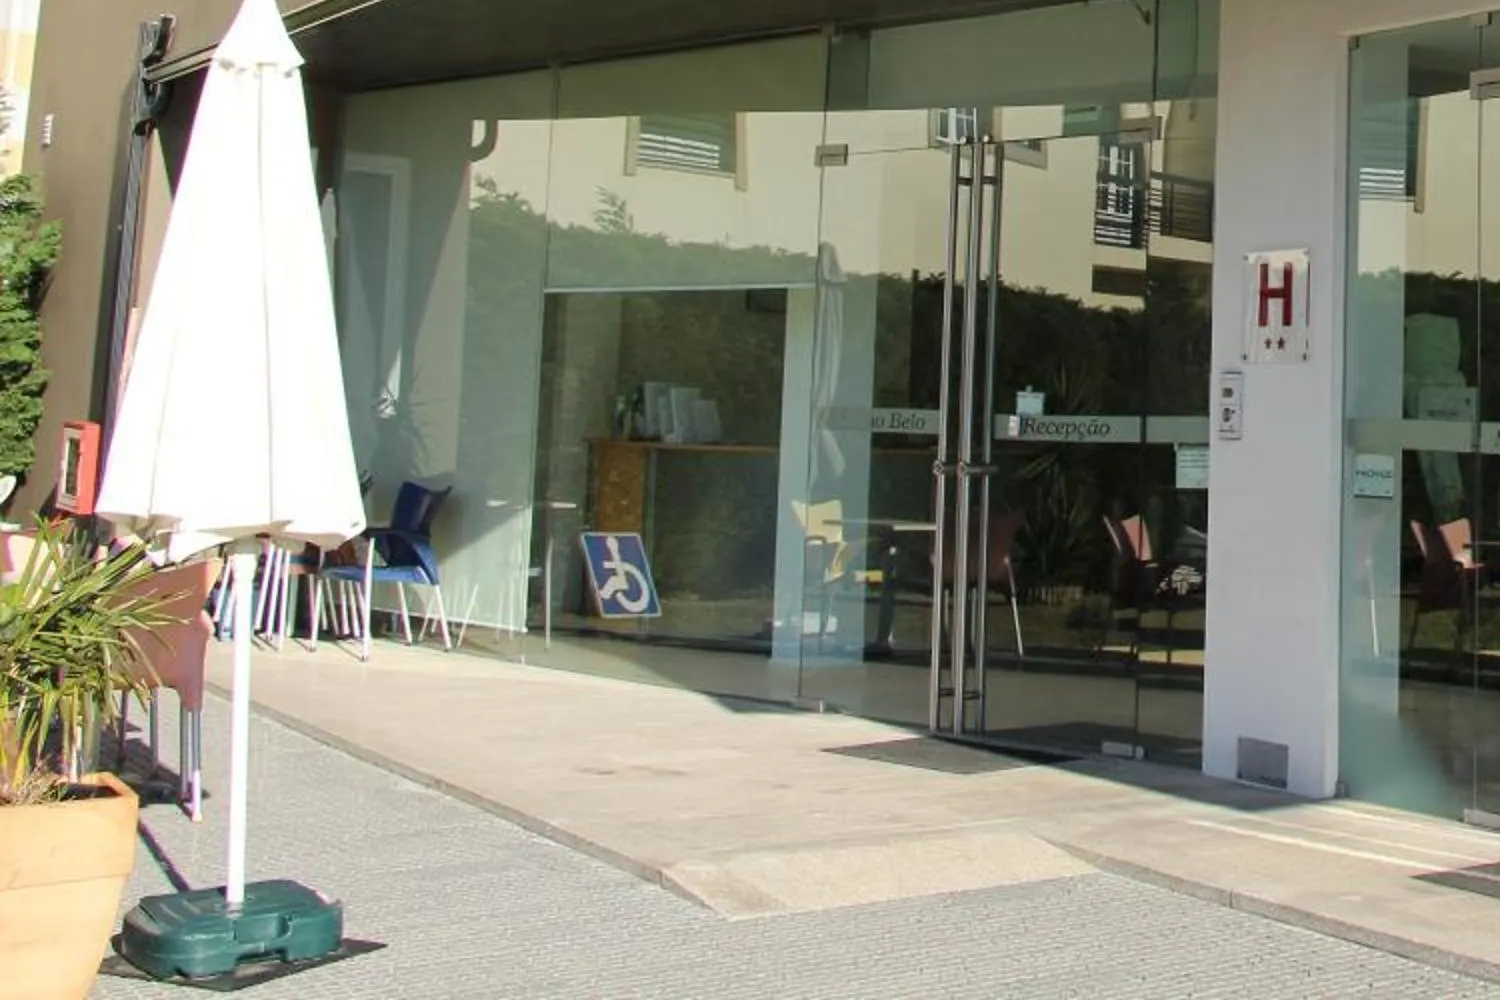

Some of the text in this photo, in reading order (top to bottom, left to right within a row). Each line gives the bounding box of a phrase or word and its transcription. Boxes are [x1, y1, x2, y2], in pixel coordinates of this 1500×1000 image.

[1258, 262, 1292, 327] H
[889, 412, 926, 430] Belo
[1023, 418, 1111, 438] Recepção
